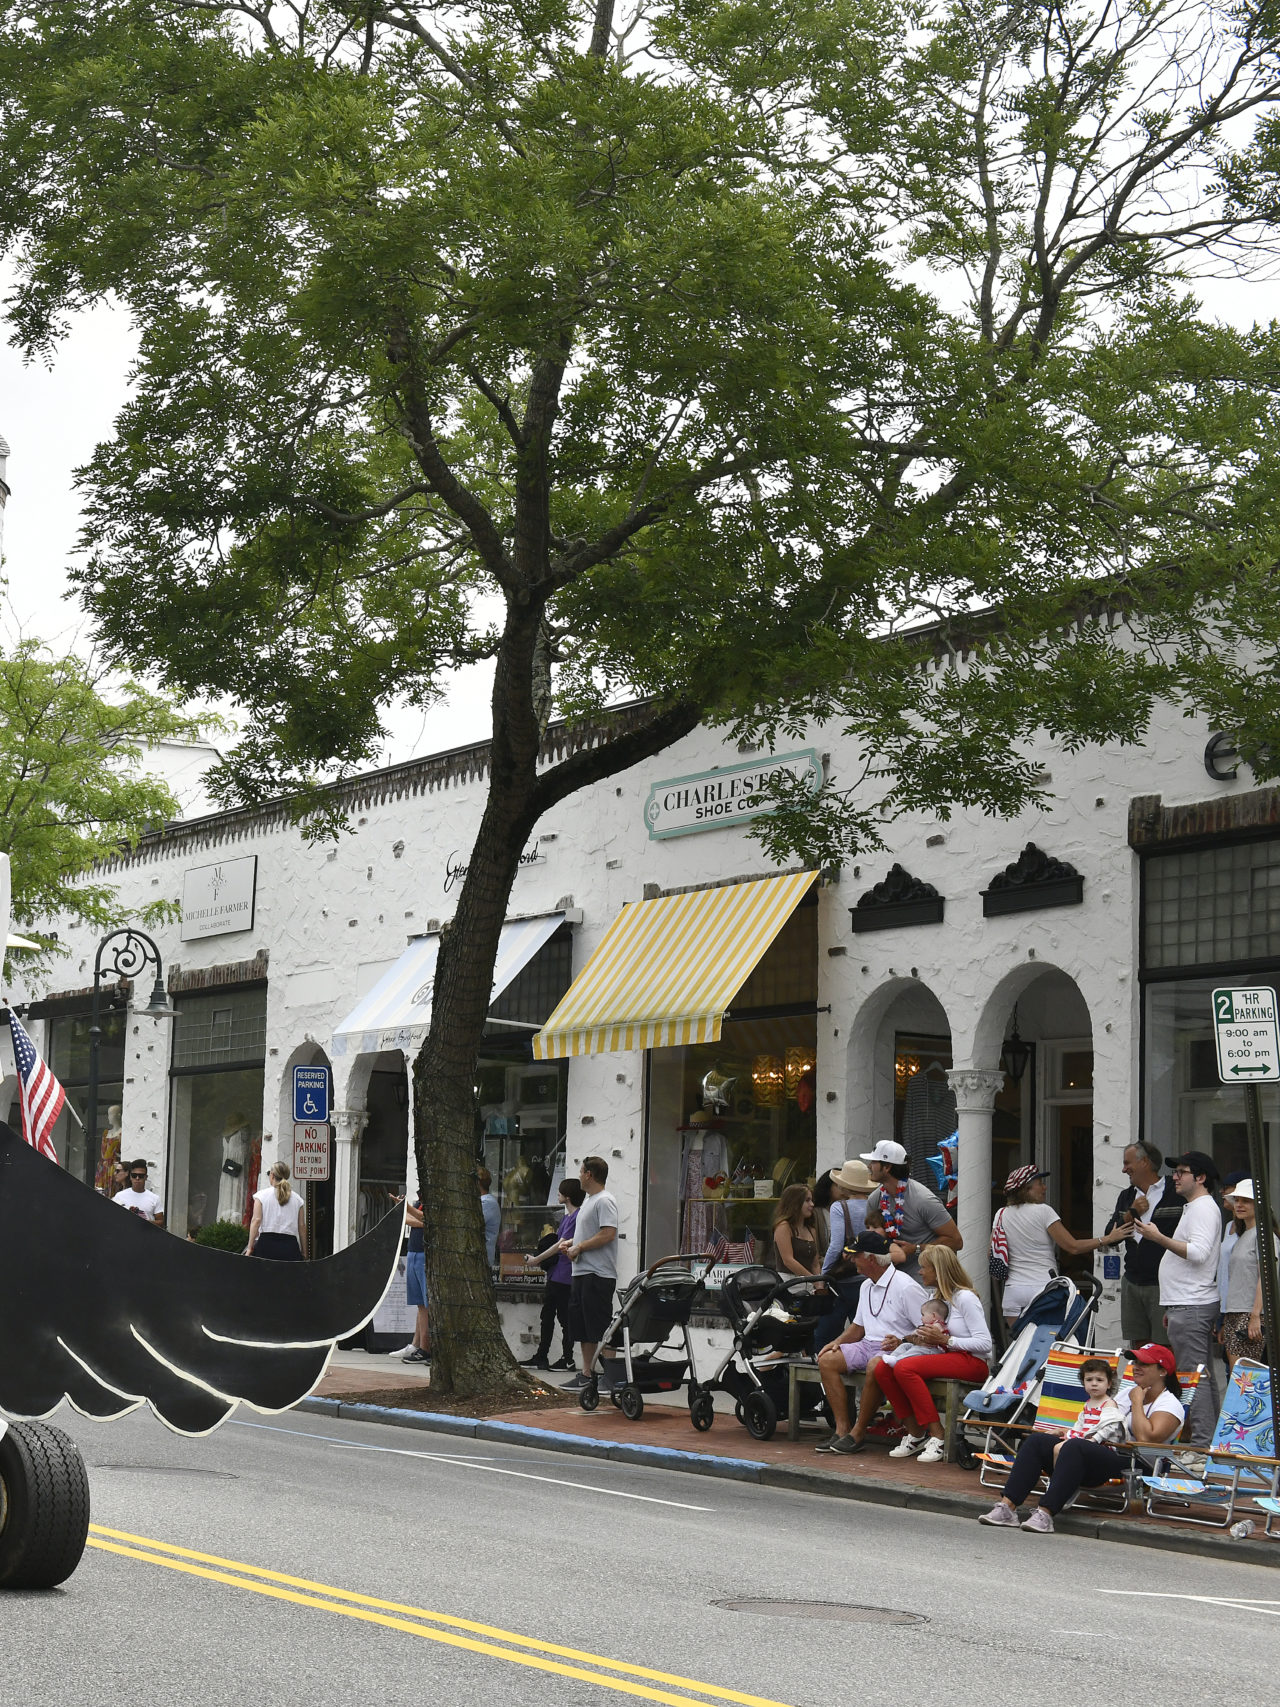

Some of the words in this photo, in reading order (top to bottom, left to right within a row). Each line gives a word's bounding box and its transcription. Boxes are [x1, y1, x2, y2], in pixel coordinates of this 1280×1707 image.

[696, 801, 732, 819] SHOE
[185, 906, 219, 921] MICHELLE
[220, 901, 249, 914] FARMER
[200, 919, 231, 931] COLLABORATE
[1244, 993, 1260, 1005] HR
[1216, 995, 1231, 1019] 2
[1234, 1007, 1273, 1020] PARKING
[1225, 1028, 1249, 1038] 9:00
[1253, 1029, 1268, 1037] am
[1242, 1039, 1253, 1047] to
[1227, 1049, 1251, 1058] 6:00
[1254, 1050, 1270, 1058] pm
[297, 1071, 325, 1080] RESERVED
[297, 1081, 325, 1089] PARKING
[304, 1128, 318, 1139] NO
[295, 1142, 327, 1153] PARKING
[299, 1156, 322, 1164] BEYOND
[296, 1167, 308, 1175] THIS
[310, 1167, 326, 1175] POINT
